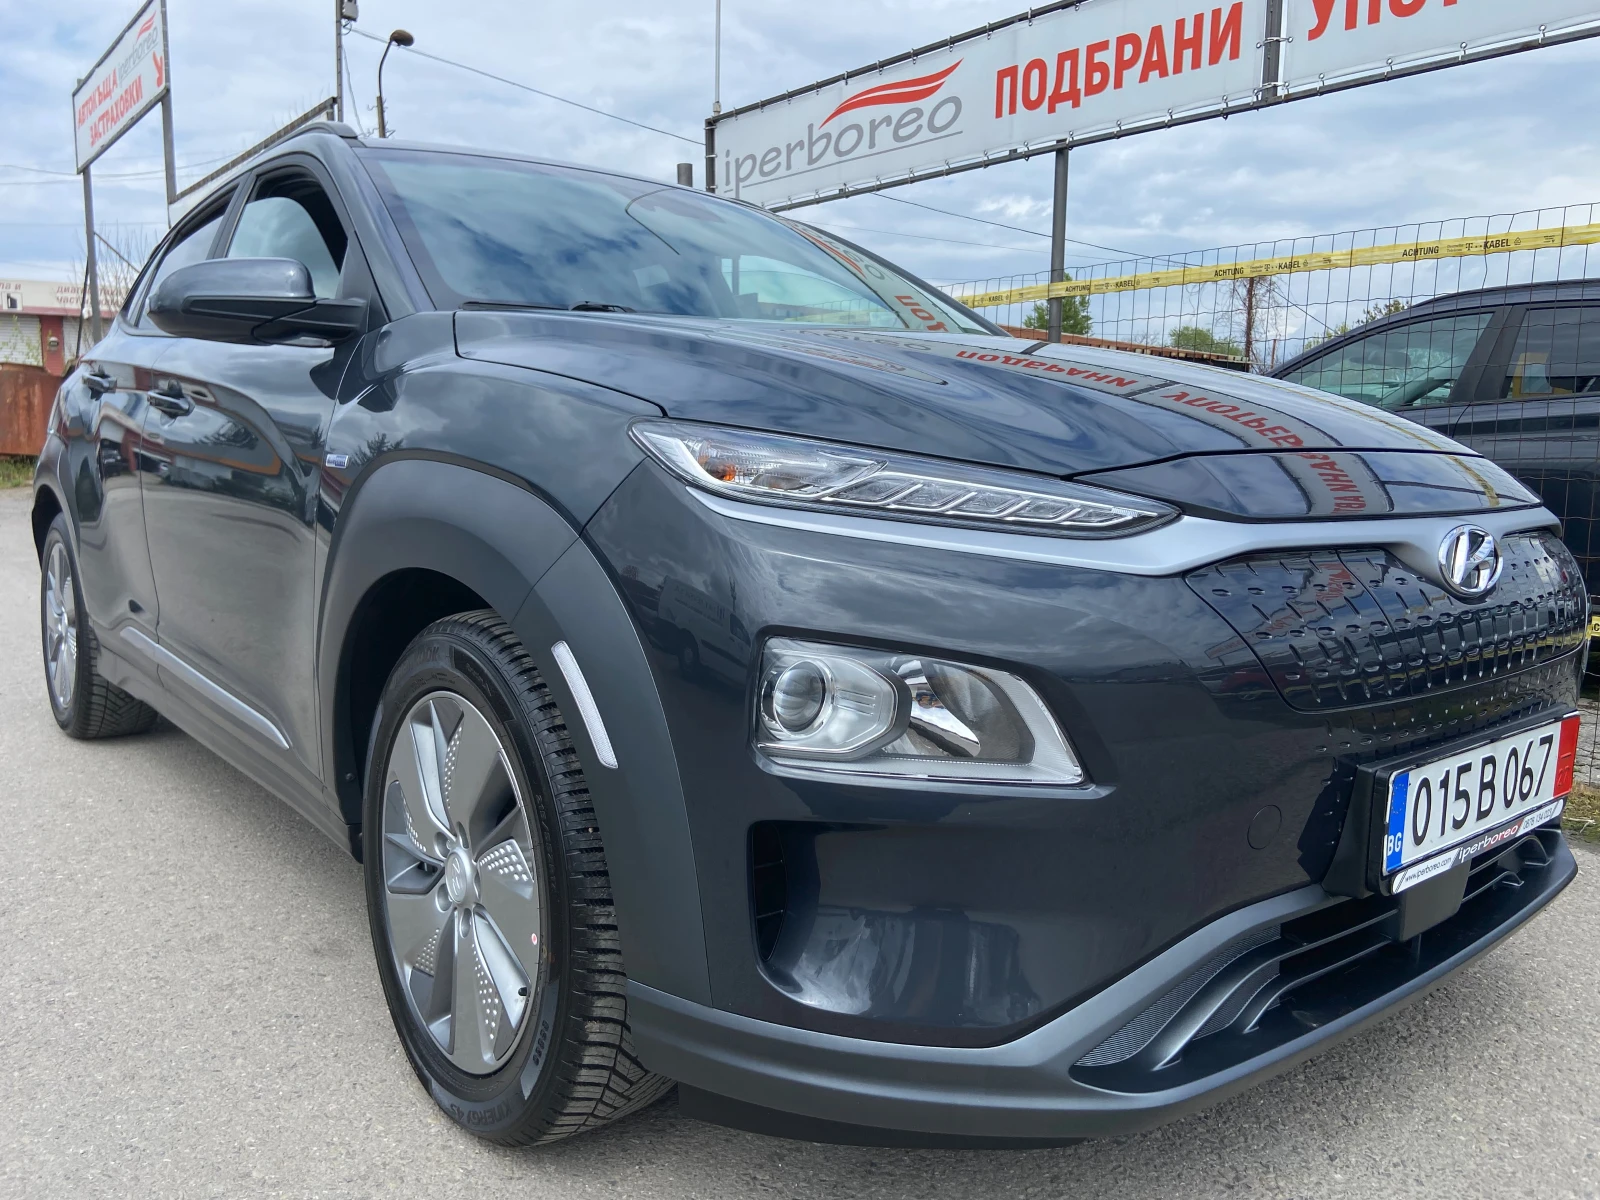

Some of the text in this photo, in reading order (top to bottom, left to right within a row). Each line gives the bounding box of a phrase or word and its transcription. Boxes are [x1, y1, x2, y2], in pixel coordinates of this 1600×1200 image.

[117, 26, 159, 87] iperboreo
[995, 1, 1243, 119] ПОДБРАНИ
[78, 68, 118, 129] АВТОКЪЩА
[89, 75, 143, 147] ЗАСТРАХОВКИ
[724, 95, 962, 198] iperboreo
[1214, 267, 1244, 277] ACHTUNG
[1278, 261, 1301, 270] KABEL
[1402, 245, 1439, 257] ACHTUNG
[1483, 239, 1511, 250] KABEL
[1065, 284, 1090, 293] ACHTUNG
[1115, 279, 1134, 288] KABEL
[1387, 832, 1402, 856] BG
[1404, 856, 1452, 882] www.iperboreo.com
[1458, 825, 1518, 863] iperboreo
